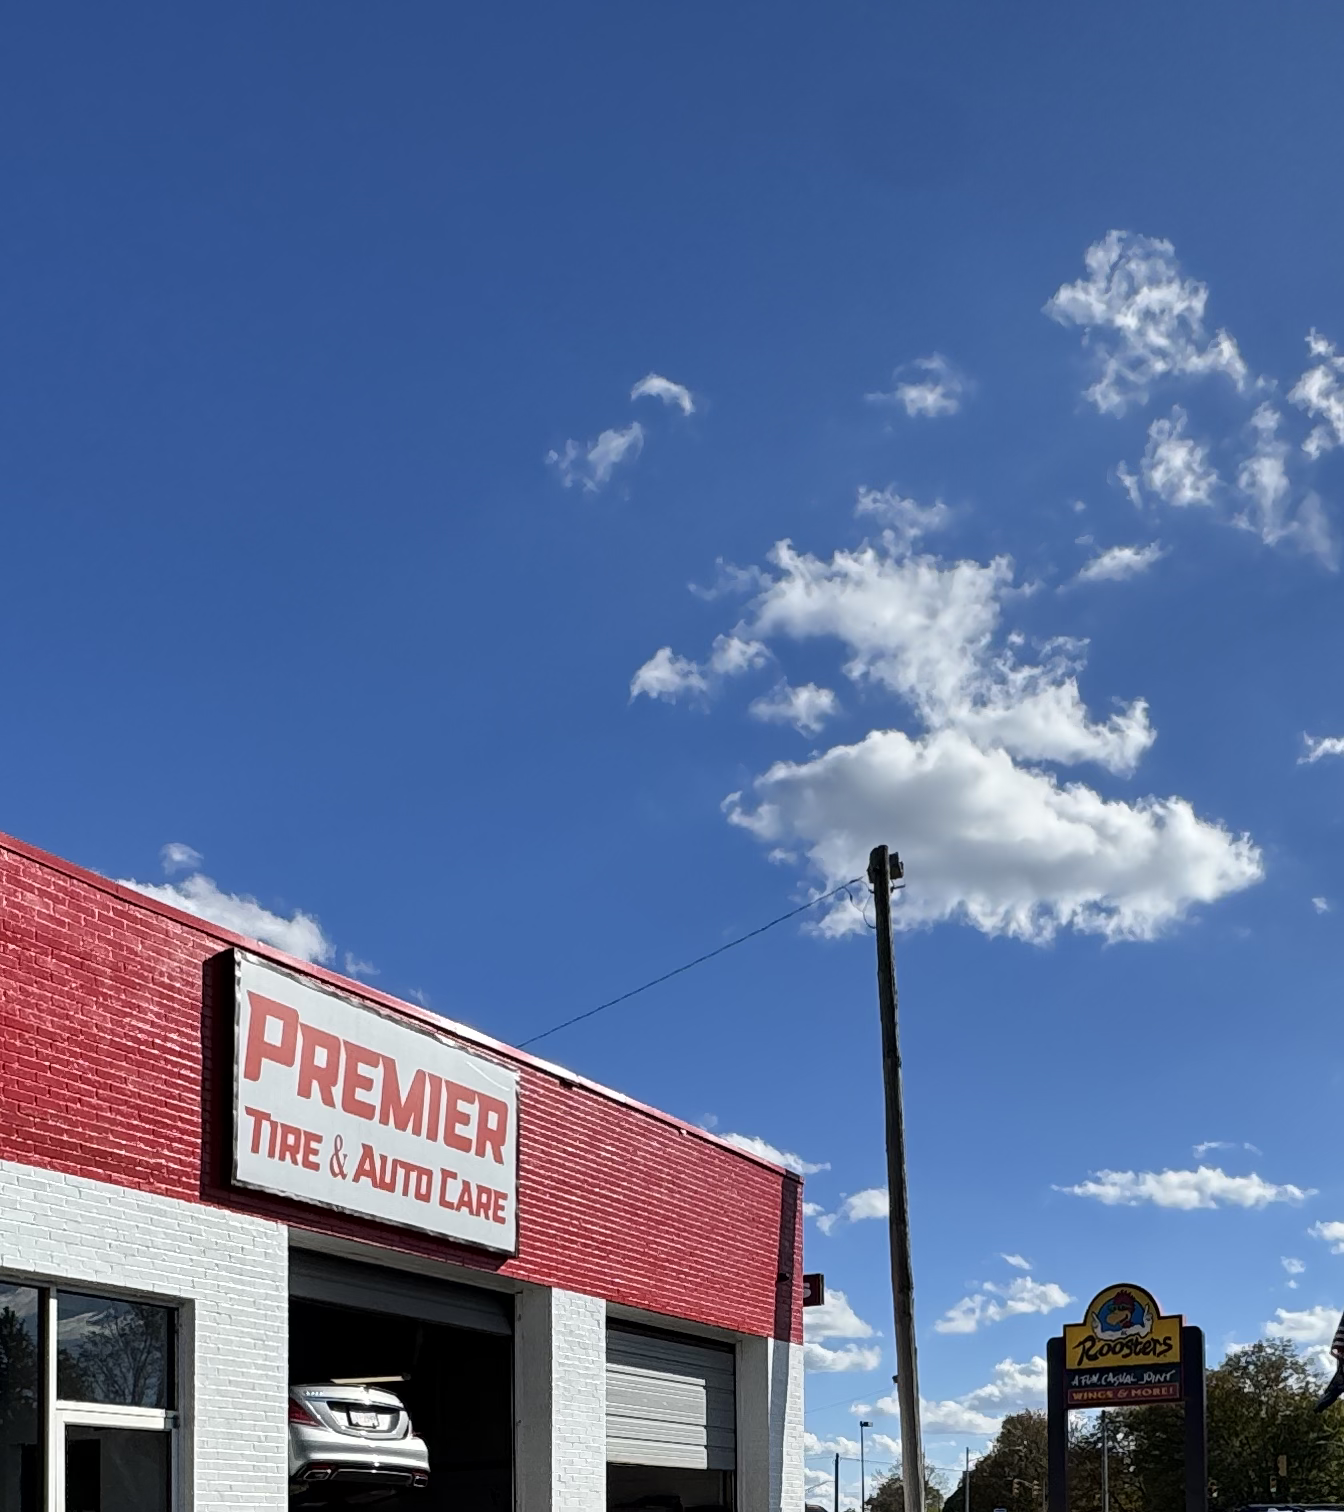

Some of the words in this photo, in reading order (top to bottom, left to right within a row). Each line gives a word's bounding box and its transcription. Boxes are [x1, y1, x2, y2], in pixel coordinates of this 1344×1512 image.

[243, 990, 509, 1165] PREMIER
[244, 1105, 324, 1172] TIRE
[329, 1134, 348, 1180] &
[352, 1143, 433, 1204] AUTO
[439, 1167, 509, 1225] CARE
[1072, 1335, 1174, 1366] Roosters
[1071, 1375, 1079, 1386] A
[1101, 1372, 1137, 1387] CASUAL
[1138, 1369, 1176, 1384] JOINT
[1072, 1390, 1114, 1400] WINGS
[1117, 1389, 1129, 1398] &
[1131, 1386, 1174, 1397] MORE!
